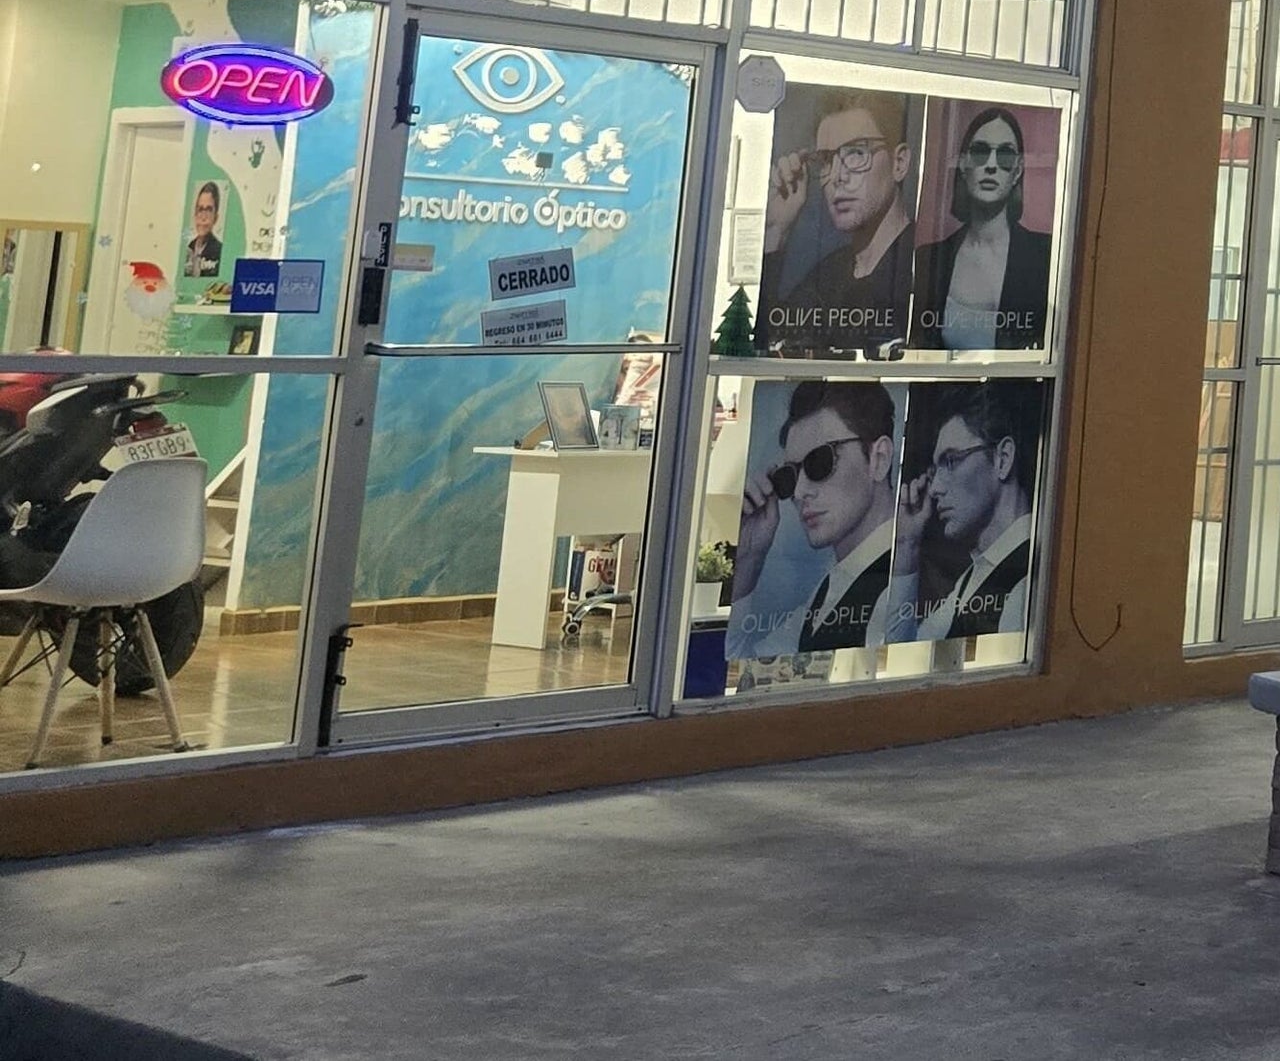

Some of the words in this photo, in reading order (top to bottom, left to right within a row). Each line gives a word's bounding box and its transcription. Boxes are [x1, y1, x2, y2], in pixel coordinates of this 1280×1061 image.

[173, 59, 325, 107] OPEN
[399, 188, 530, 226] onsultorio
[533, 188, 630, 234] Óptico
[240, 281, 275, 296] VISA
[497, 263, 570, 293] CERRADO
[769, 308, 822, 327] OLIVE
[828, 309, 895, 328] PEOPLE
